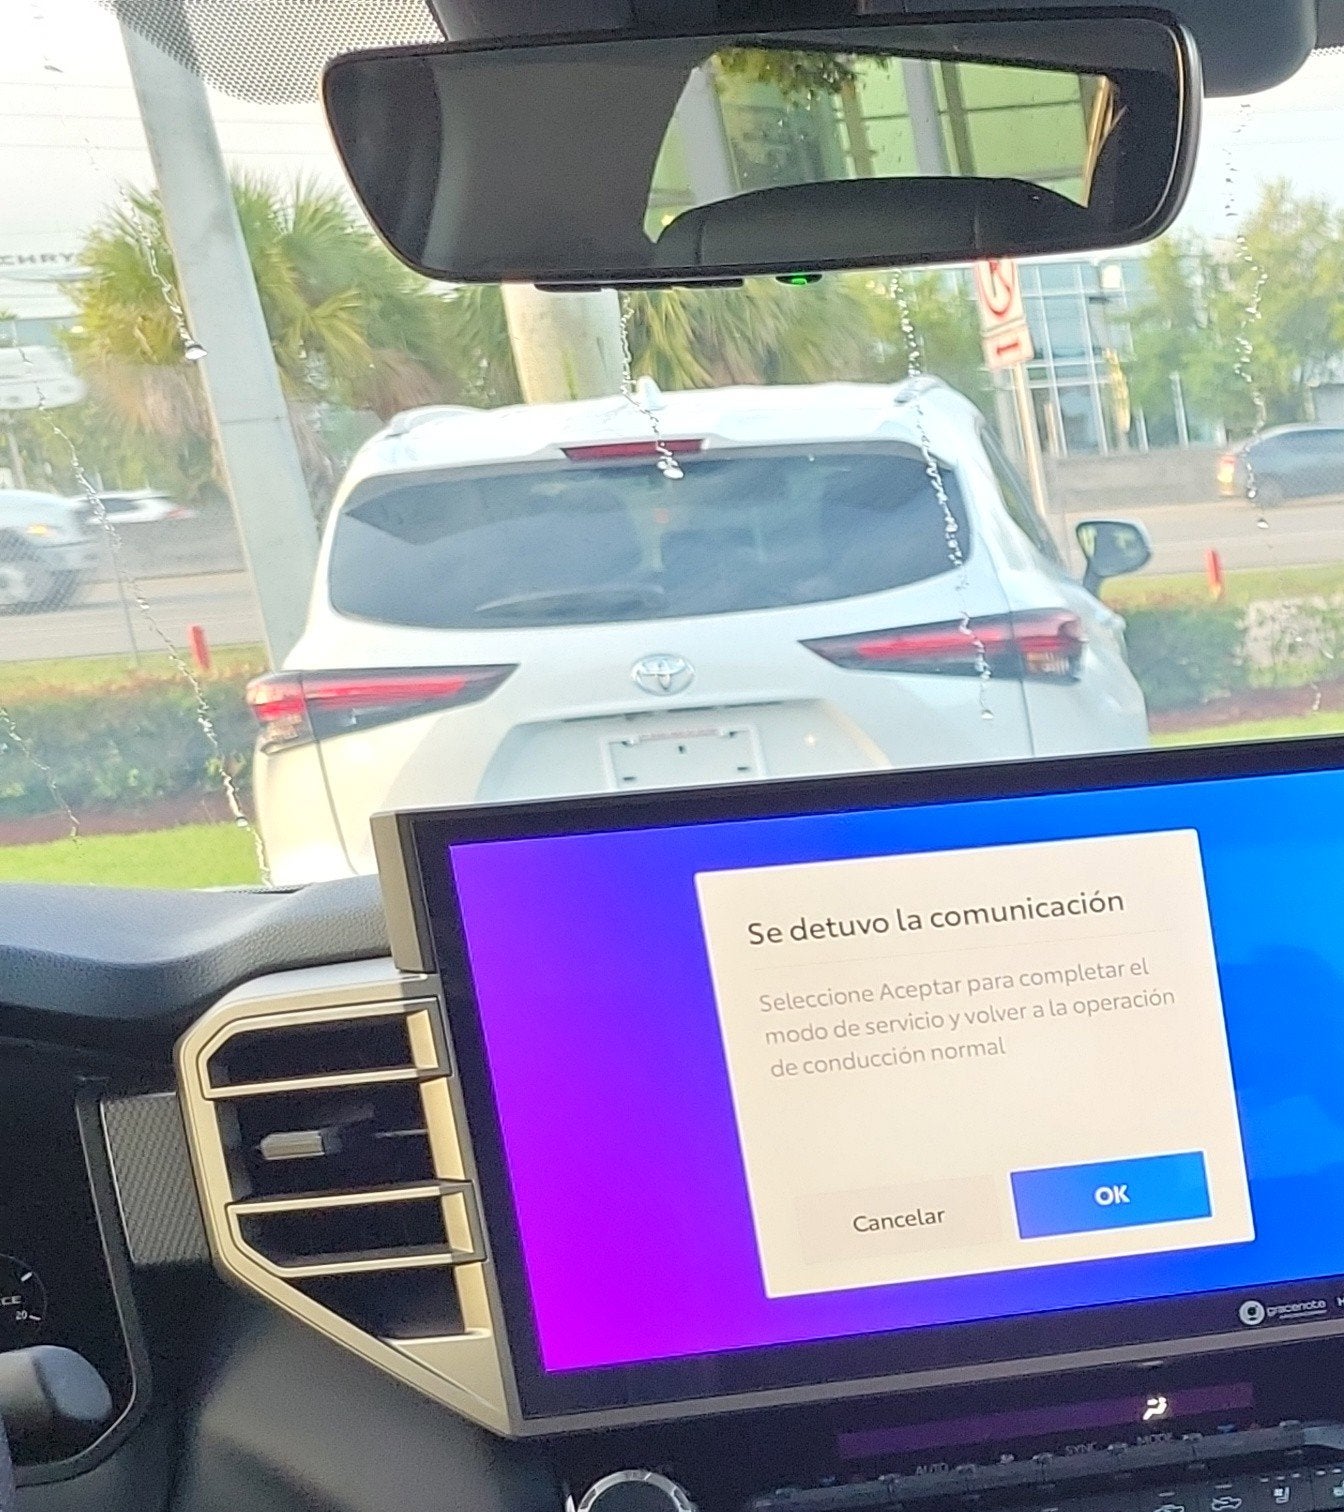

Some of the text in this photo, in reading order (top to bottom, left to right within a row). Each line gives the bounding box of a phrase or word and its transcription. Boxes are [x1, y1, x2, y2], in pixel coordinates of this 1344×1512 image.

[748, 889, 1125, 945] Se detuvo la comunicación
[759, 957, 1150, 1012] Seleccione Aceptar para completar el
[765, 988, 1176, 1046] modo de servicio y volver a la operación
[770, 1036, 1007, 1078] de conducción normal
[1094, 1184, 1130, 1206] OK
[852, 1207, 946, 1233] Cancelar
